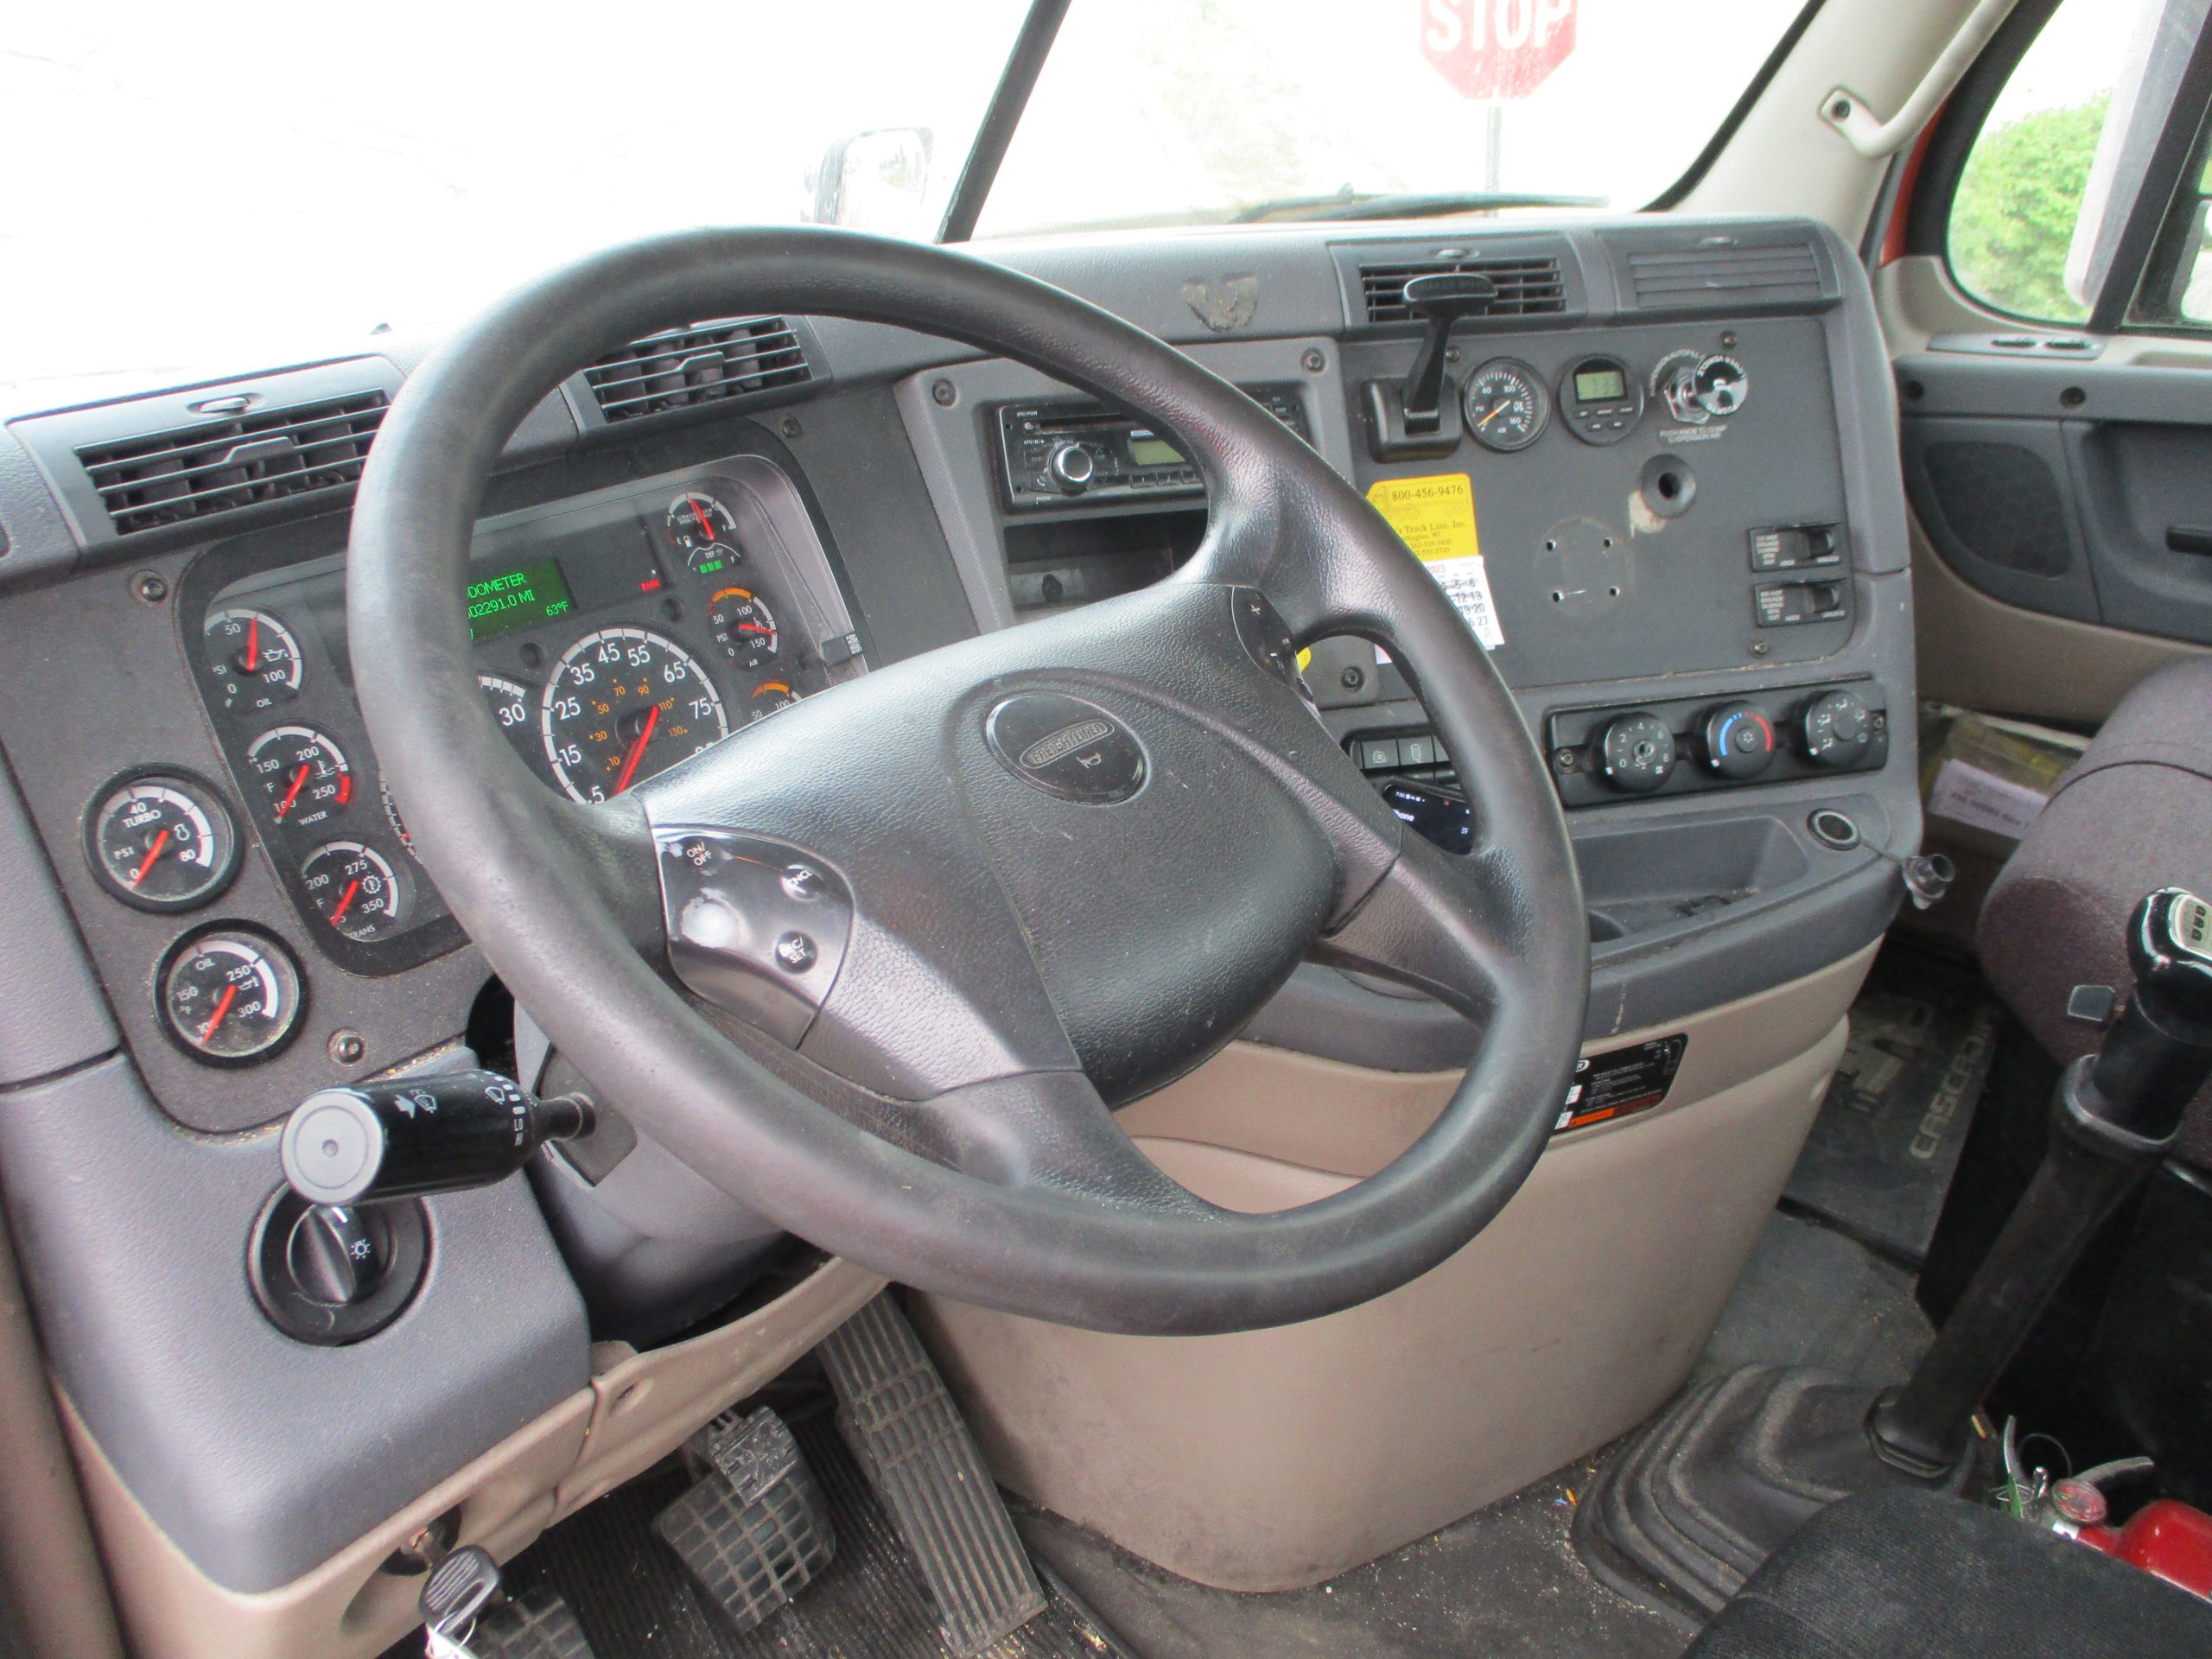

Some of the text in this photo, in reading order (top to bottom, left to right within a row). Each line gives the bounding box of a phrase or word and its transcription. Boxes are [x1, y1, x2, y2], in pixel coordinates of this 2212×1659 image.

[1392, 486, 1464, 501] 800-456-9476
[1404, 524, 1427, 533] Truck
[467, 573, 527, 599] DOMETER
[1454, 580, 1461, 589] 5
[1469, 578, 1476, 588] 6
[518, 589, 536, 604] MI
[1470, 591, 1482, 601] 13
[736, 605, 753, 616] 100
[1473, 603, 1485, 613] 20
[713, 614, 724, 624] 50
[1477, 615, 1488, 626] 27
[225, 623, 241, 635] 50
[750, 637, 766, 649] 150
[598, 642, 620, 664] 45
[627, 645, 651, 666] 55
[263, 670, 286, 683] 100
[570, 663, 594, 685] 35
[664, 662, 685, 683] 65
[613, 686, 626, 696] 70
[638, 685, 649, 696] 90
[257, 697, 272, 708] OIL
[555, 697, 581, 720] 25
[597, 703, 609, 715] 50
[658, 701, 672, 711] 110
[689, 697, 712, 719] 75
[499, 703, 526, 727] 30
[595, 731, 607, 742] 30
[668, 726, 683, 738] 130
[1619, 734, 1626, 743] 2
[296, 747, 319, 761] 200
[559, 745, 582, 766] 15
[608, 756, 620, 766] 10
[257, 760, 280, 774] 150
[313, 784, 336, 800] 250
[130, 802, 147, 815] 40
[122, 809, 162, 829] TURBO
[298, 810, 328, 825] WATER
[113, 847, 136, 860] PSI
[180, 849, 196, 862] 80
[686, 842, 705, 859] ON/
[694, 850, 712, 866] OFF
[345, 860, 368, 876] 275
[306, 874, 329, 891] 200
[361, 898, 385, 915] 350
[790, 949, 807, 964] SET
[195, 957, 215, 971] OIL
[226, 964, 251, 982] 250
[176, 986, 199, 1002] 150
[237, 1001, 261, 1019] 300
